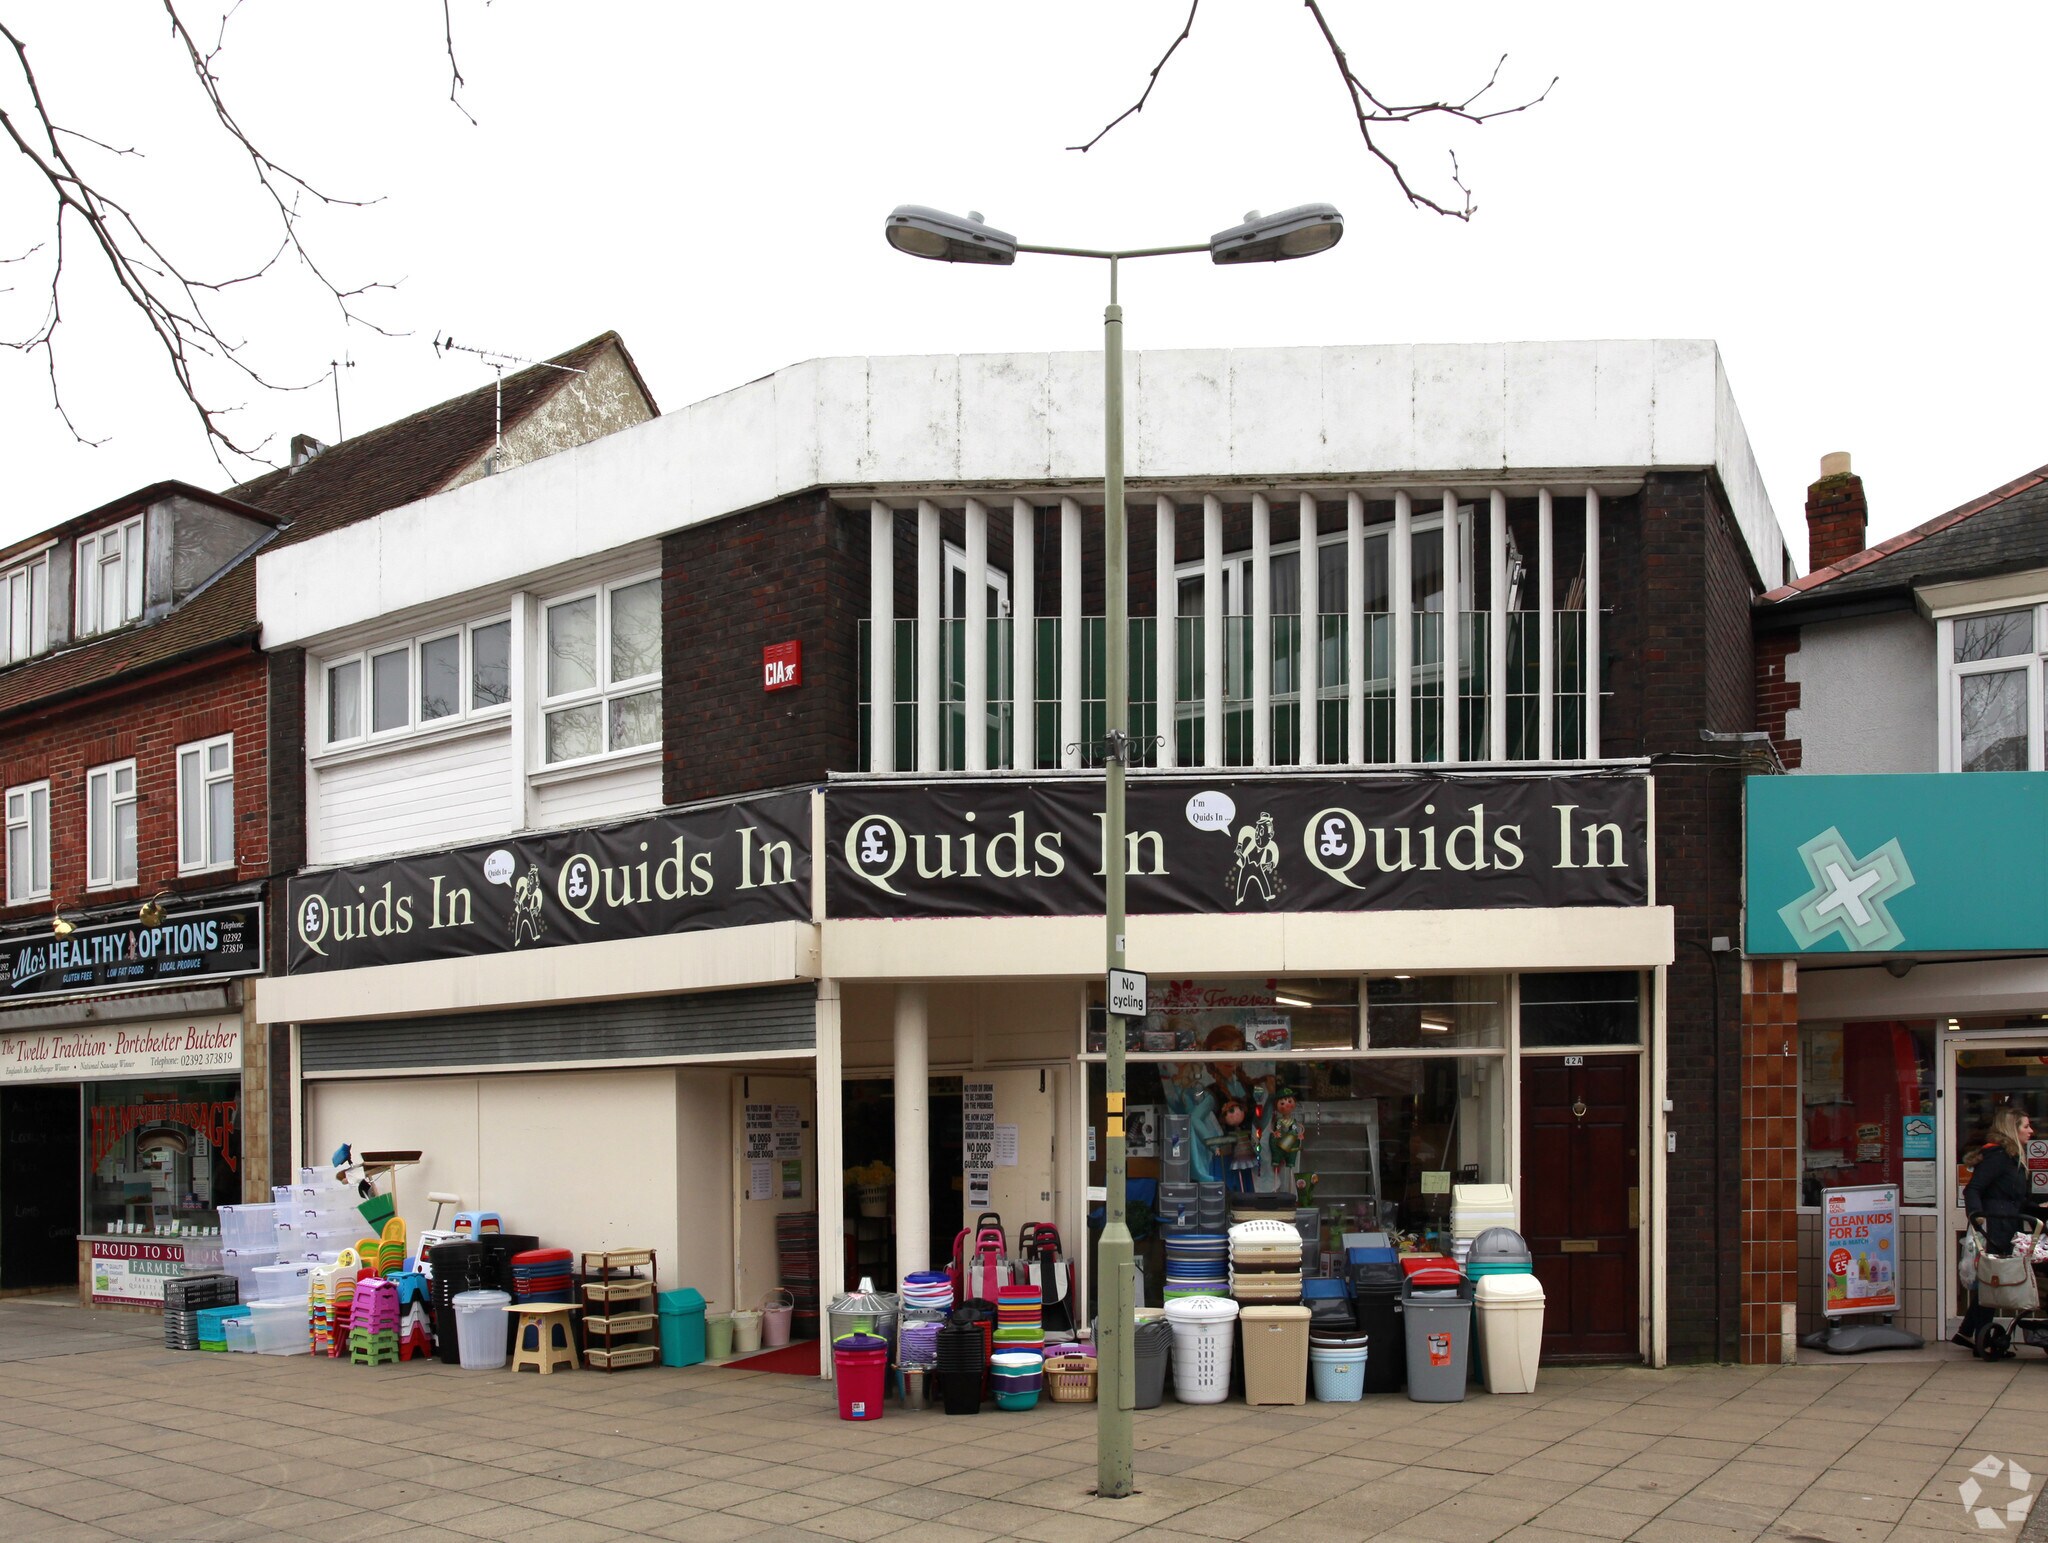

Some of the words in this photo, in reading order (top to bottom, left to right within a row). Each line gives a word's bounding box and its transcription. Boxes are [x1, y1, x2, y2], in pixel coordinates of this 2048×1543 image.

[765, 660, 785, 686] CIA
[1193, 799, 1205, 807] I'm
[1192, 813, 1214, 823] Quids
[1215, 813, 1223, 821] In
[844, 810, 1065, 896] Quids
[1303, 803, 1524, 890] Quids
[1551, 805, 1628, 869] In
[557, 835, 714, 925] Quids
[735, 826, 797, 890] In
[298, 881, 414, 956] Quids
[428, 875, 475, 930] In
[222, 932, 242, 943] 02392
[49, 933, 127, 970] HEALTHY
[138, 920, 218, 958] OPTIONS
[221, 944, 244, 954] 373819
[62, 973, 80, 983] GLUTEN
[80, 971, 93, 981] FREE
[107, 968, 118, 978] LOW
[118, 967, 127, 976] FAT
[127, 965, 144, 975] FOODS
[159, 960, 176, 972] LOCAL
[177, 959, 201, 970] PRODUCE
[1122, 977, 1135, 991] No
[1113, 994, 1144, 1011] cycling
[1, 1039, 15, 1055] The
[17, 1036, 49, 1062] Twells
[52, 1033, 106, 1059] Tradition
[115, 1027, 183, 1055] Portchester
[185, 1022, 237, 1051] Butcher
[180, 1053, 203, 1067] 02392
[204, 1052, 233, 1065] 373819
[91, 1103, 167, 1175] HAMPSHIRE
[169, 1101, 237, 1173] SAUSAGE
[749, 1133, 756, 1143] NO
[757, 1133, 771, 1143] DOGS
[747, 1150, 761, 1159] GUIDE
[762, 1150, 773, 1158] DOGS
[966, 1143, 975, 1152] NO
[976, 1143, 991, 1152] DOGS
[964, 1160, 979, 1168] GUIDE
[980, 1160, 993, 1168] DOGS
[1828, 1215, 1865, 1227] CLEAN
[1866, 1213, 1893, 1225] KIDS
[1829, 1227, 1853, 1239] FOR
[1855, 1226, 1869, 1238] £5
[94, 1243, 138, 1257] PROUD
[143, 1245, 160, 1259] TO
[1835, 1260, 1847, 1273] £5
